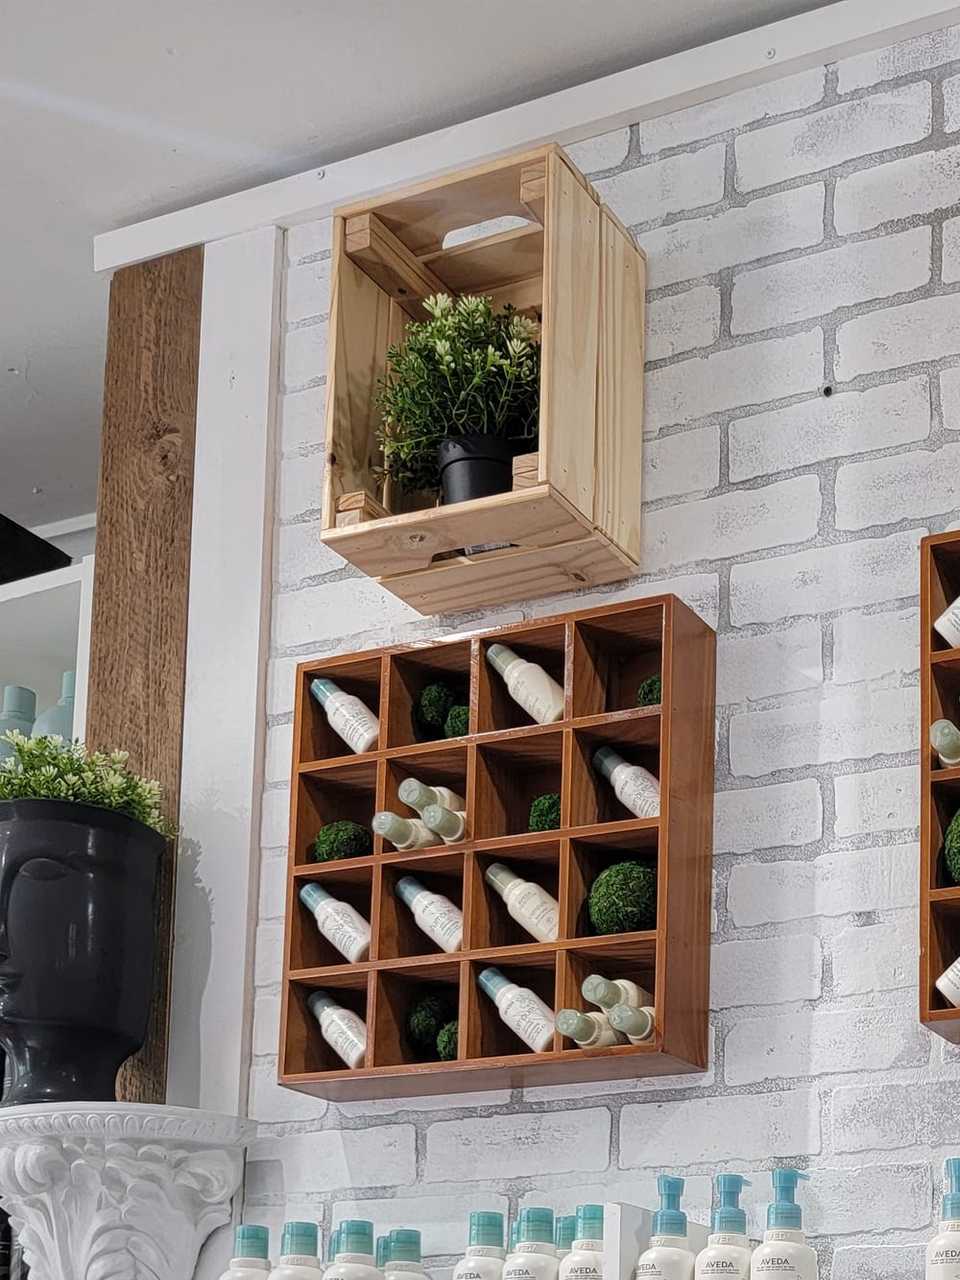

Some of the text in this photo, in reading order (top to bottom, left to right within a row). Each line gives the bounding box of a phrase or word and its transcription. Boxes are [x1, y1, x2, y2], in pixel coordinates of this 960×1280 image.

[705, 1260, 735, 1269] AVEDA
[760, 1257, 790, 1266] AVEDA
[569, 1266, 598, 1275] AVEDA
[638, 1263, 657, 1271] VEDA
